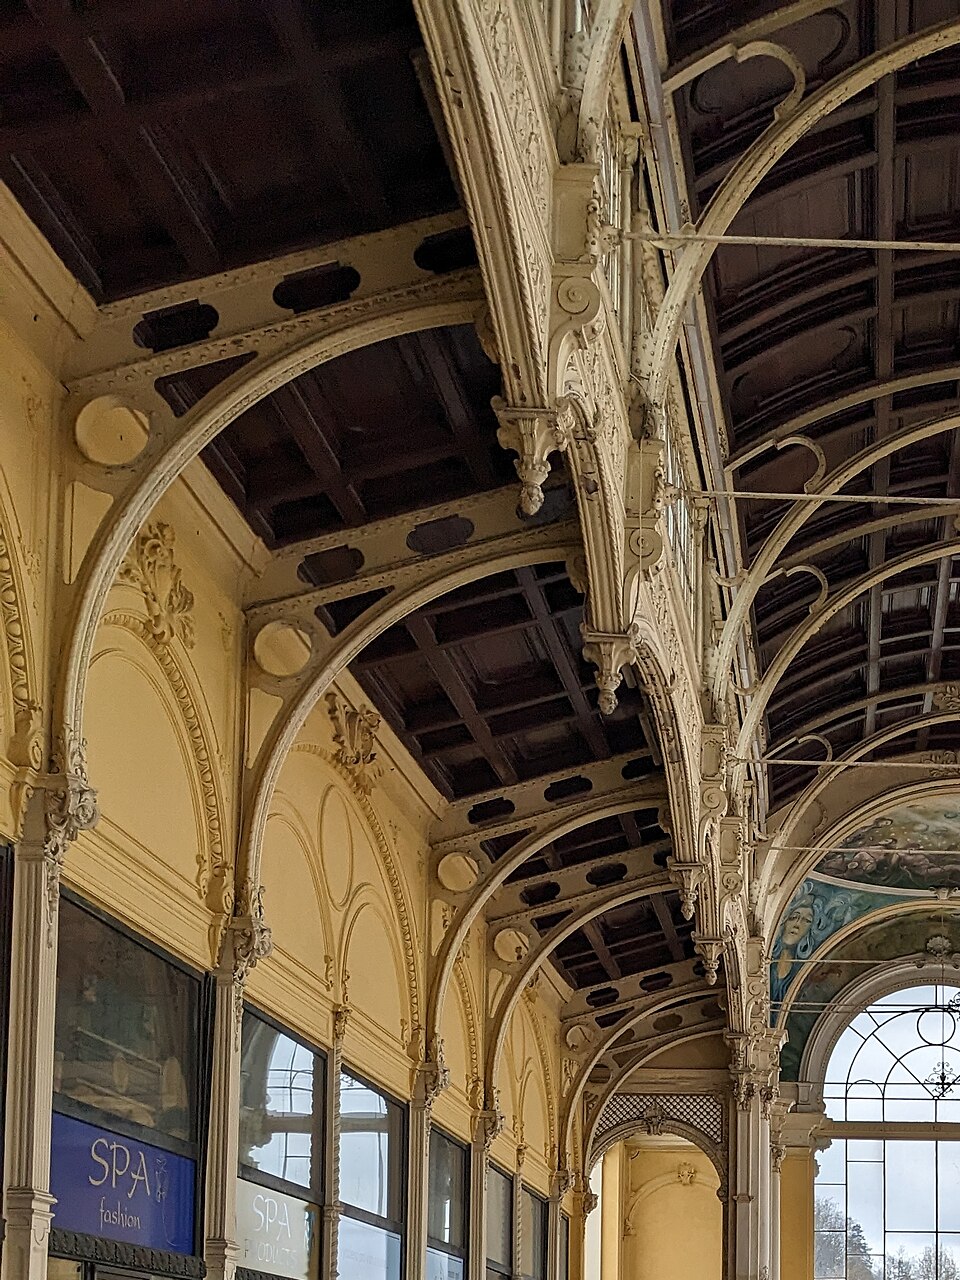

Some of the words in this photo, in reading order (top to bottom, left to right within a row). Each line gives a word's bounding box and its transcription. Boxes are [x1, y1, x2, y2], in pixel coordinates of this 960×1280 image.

[88, 1138, 151, 1199] SPA
[99, 1196, 141, 1231] fashion
[252, 1194, 291, 1241] SPA
